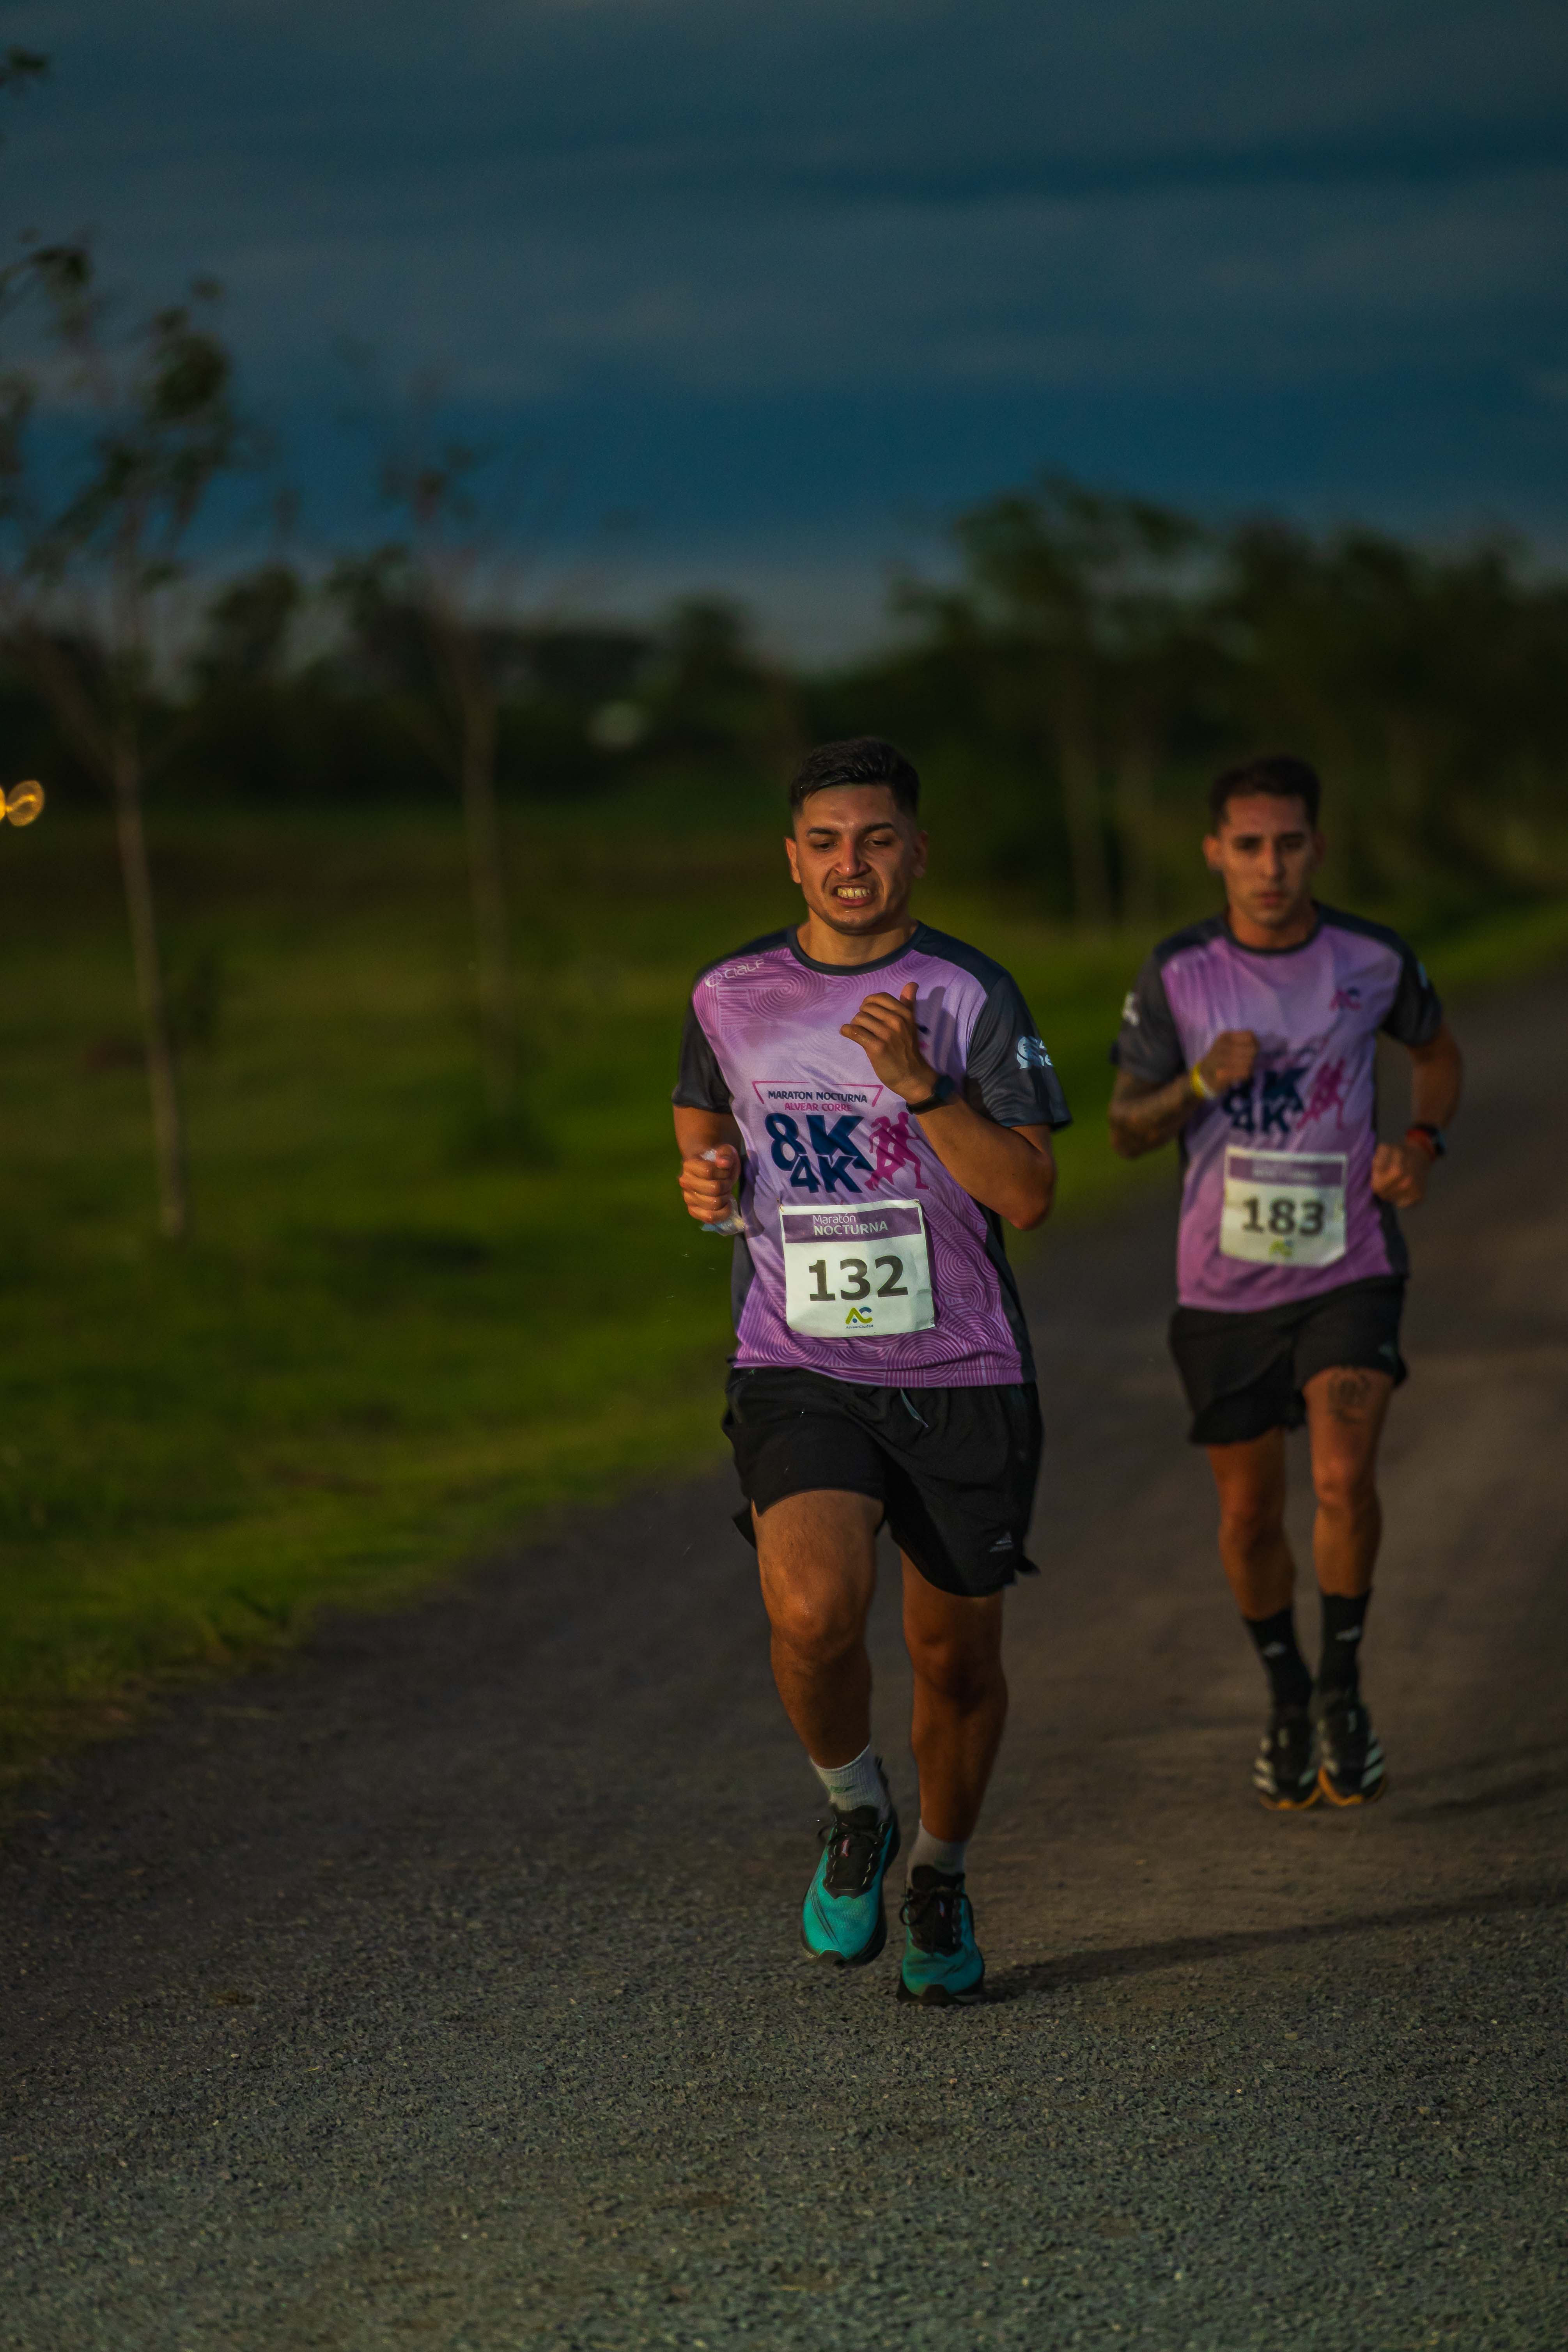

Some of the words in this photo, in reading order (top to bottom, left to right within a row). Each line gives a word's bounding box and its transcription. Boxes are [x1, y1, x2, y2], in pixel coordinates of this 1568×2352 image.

[768, 1091, 813, 1100] MARATON
[816, 1091, 868, 1103] NOCTURNA
[785, 1102, 819, 1111] ALVEAR
[822, 1103, 852, 1112] CORRE
[765, 1112, 875, 1172] 8K
[790, 1156, 863, 1194] 4K
[813, 1213, 856, 1224] Maratón
[813, 1221, 888, 1236] NOCTURNA
[1242, 1197, 1324, 1236] 183
[808, 1255, 908, 1302] 132
